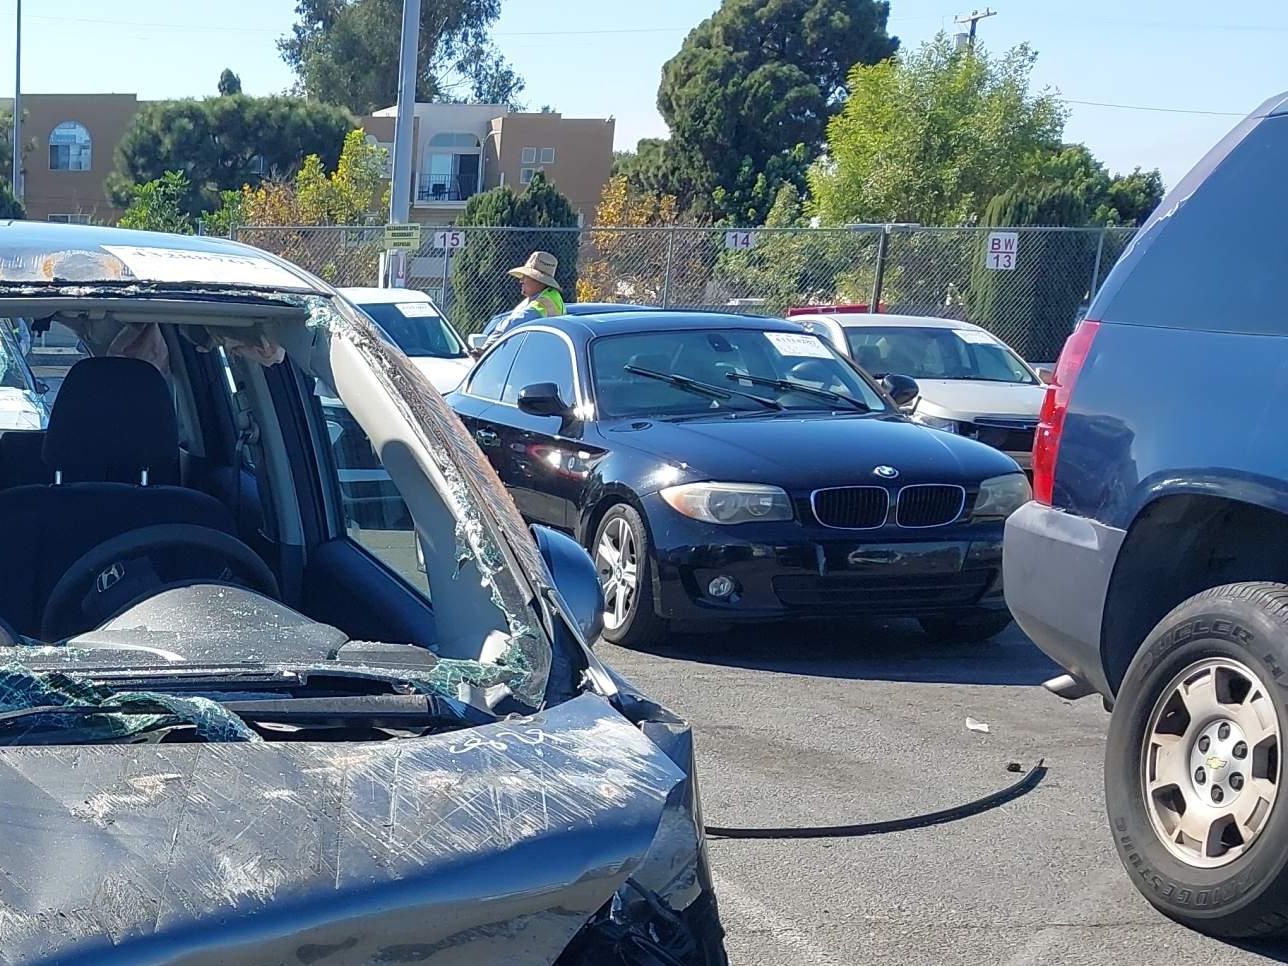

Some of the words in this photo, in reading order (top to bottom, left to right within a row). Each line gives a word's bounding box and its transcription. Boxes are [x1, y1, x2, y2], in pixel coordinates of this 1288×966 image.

[440, 232, 460, 247] 15
[732, 233, 750, 247] 14
[991, 238, 1015, 250] BW
[993, 254, 1012, 268] 13
